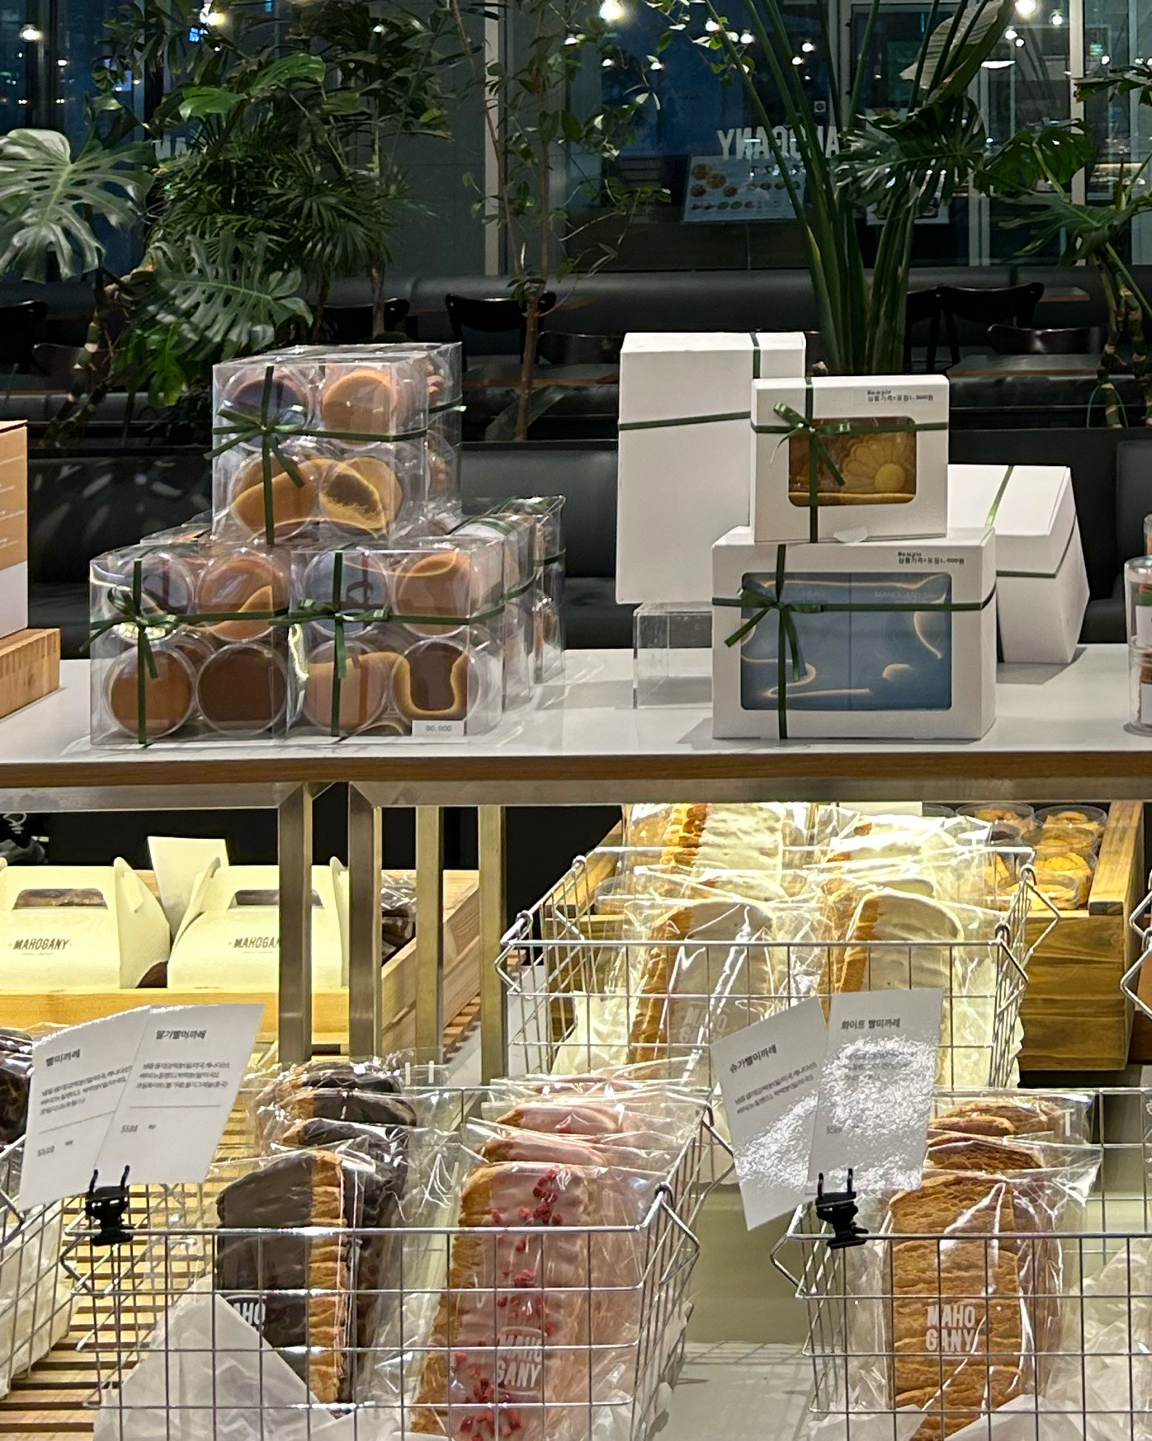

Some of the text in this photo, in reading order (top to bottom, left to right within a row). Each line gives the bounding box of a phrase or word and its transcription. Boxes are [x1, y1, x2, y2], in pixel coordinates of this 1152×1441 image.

[13, 939, 69, 950] MAHOGANY
[841, 1019, 865, 1030] 화이트
[927, 1304, 976, 1328] MAHO
[925, 1329, 976, 1352] GANY
